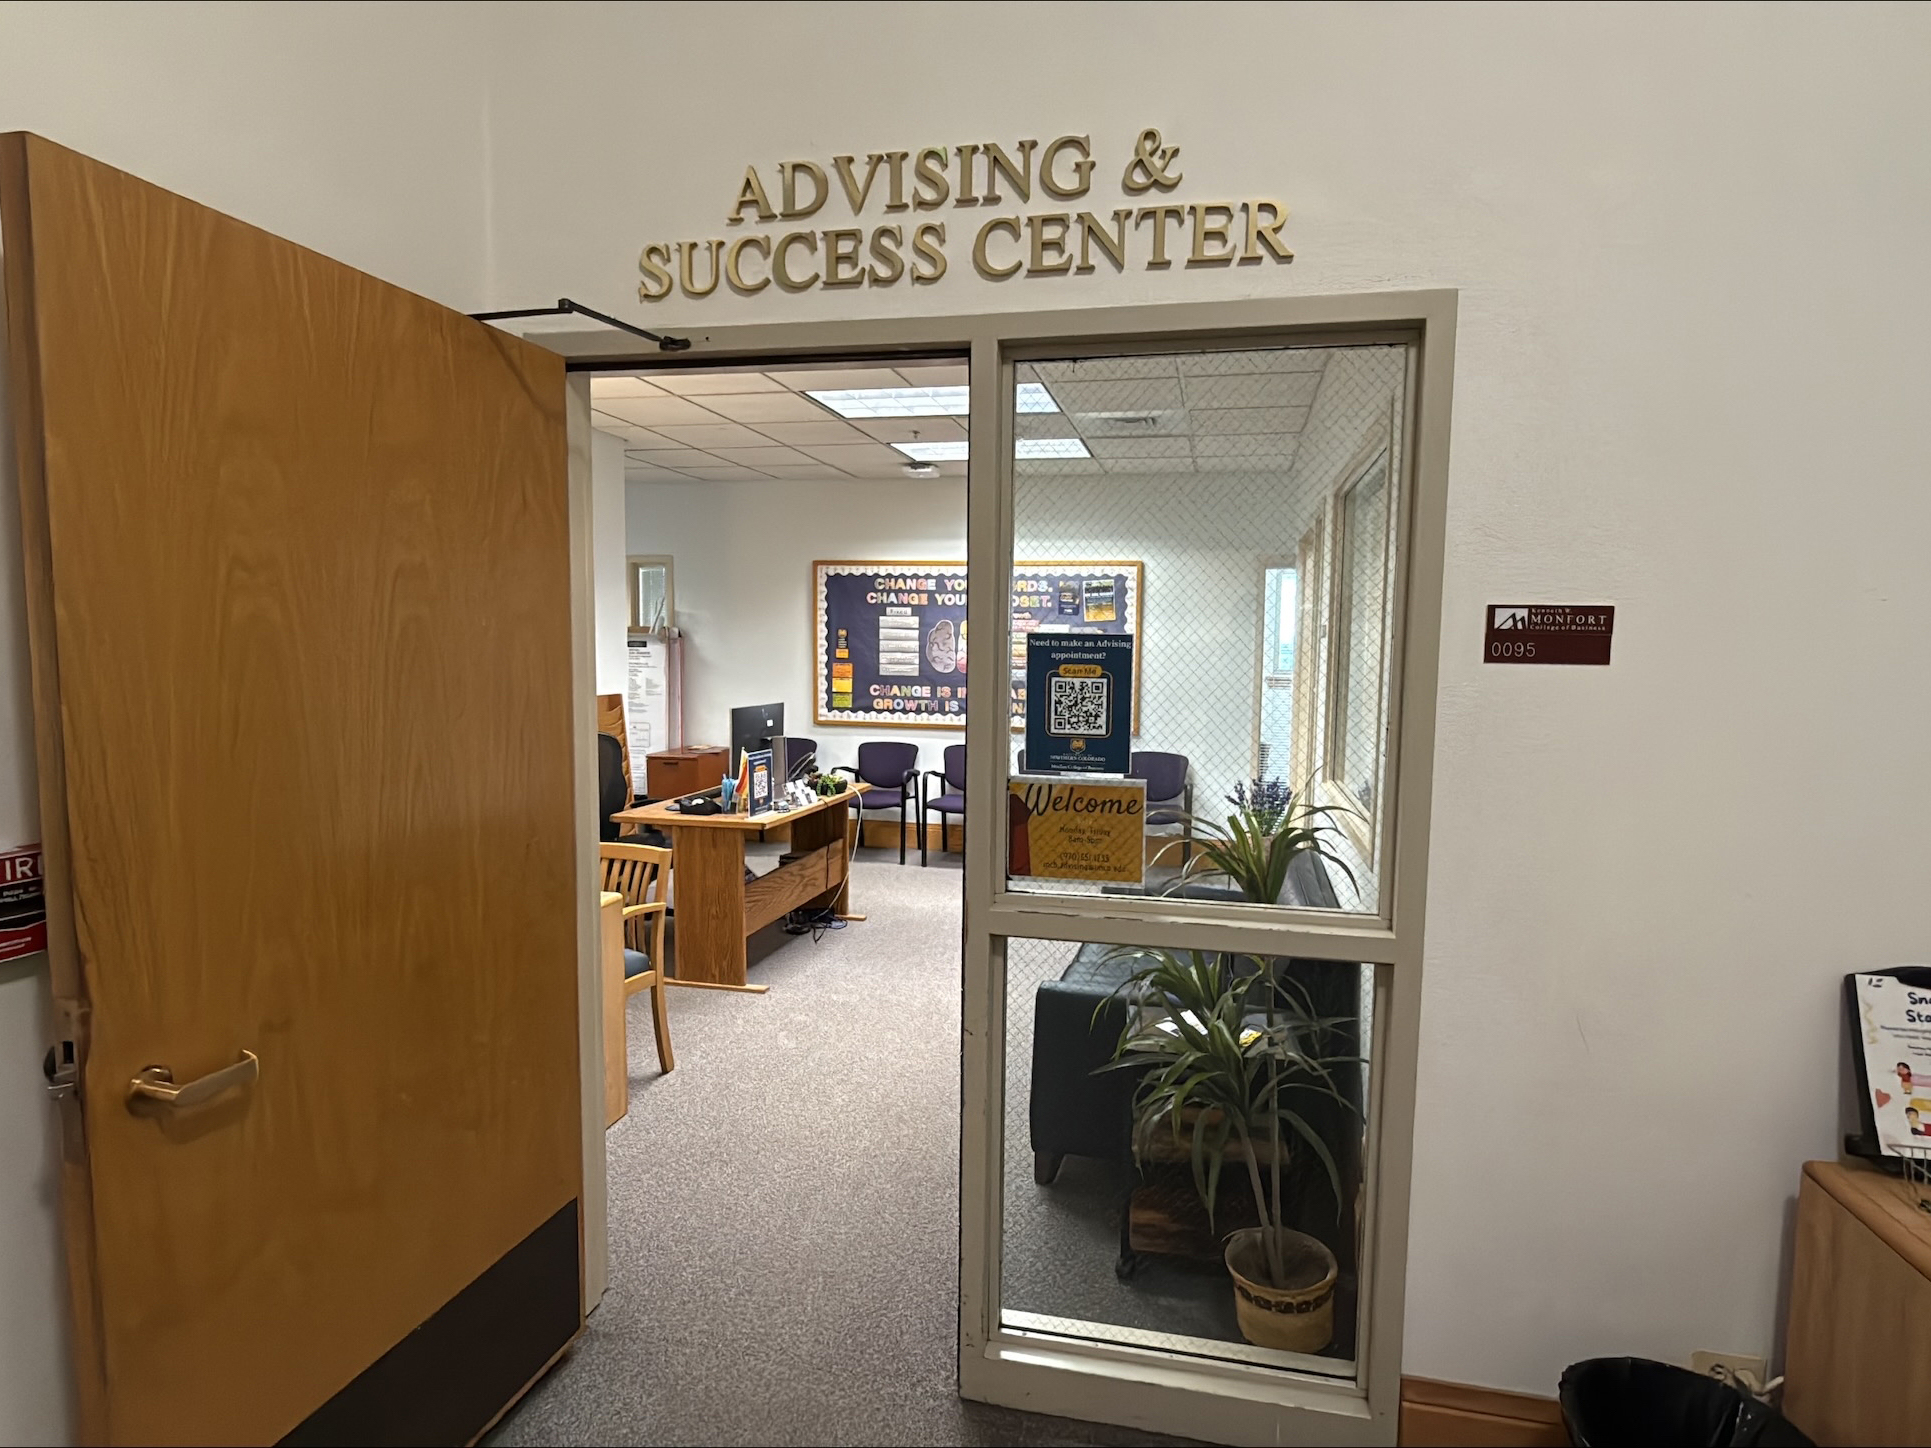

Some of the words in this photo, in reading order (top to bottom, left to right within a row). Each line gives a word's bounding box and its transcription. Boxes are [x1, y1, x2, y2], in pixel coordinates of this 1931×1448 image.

[727, 134, 1097, 224] ADVISING
[1122, 127, 1183, 193] &
[638, 221, 948, 302] SUCCESS
[972, 200, 1294, 278] CENTER
[874, 578, 936, 591] CHANGE
[944, 579, 967, 592] YO
[866, 592, 928, 606] CHANGE
[935, 593, 967, 606] YOU
[1530, 614, 1607, 625] MONFORT
[1029, 639, 1050, 647] Need
[1061, 639, 1083, 648] make
[1096, 640, 1132, 649] Advising
[1491, 641, 1536, 658] 0095
[1051, 651, 1106, 661] appointment?
[1063, 667, 1083, 675] Scan
[1084, 667, 1098, 675] Me
[869, 684, 931, 698] CHANGE
[937, 686, 951, 699] IS
[873, 698, 939, 711] GROWTH
[944, 700, 960, 712] IS
[1024, 783, 1144, 817] Welcome
[1907, 992, 1931, 1005] Sn
